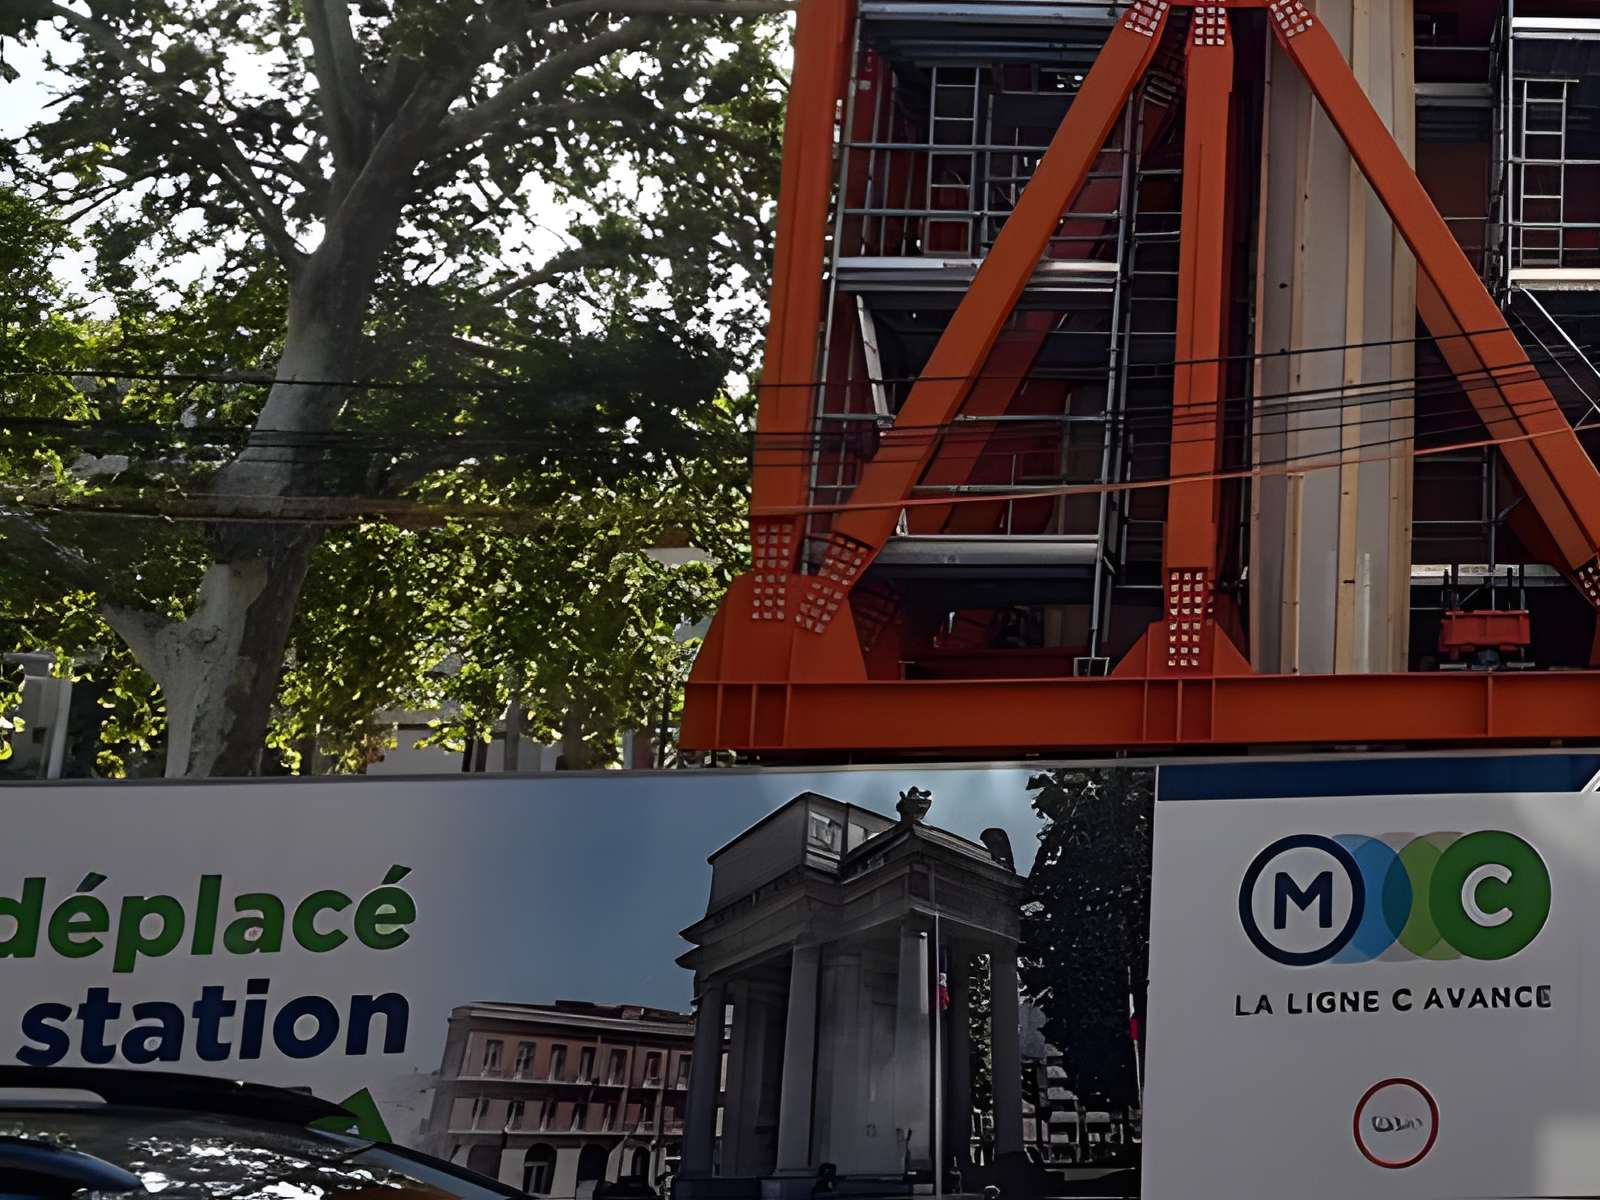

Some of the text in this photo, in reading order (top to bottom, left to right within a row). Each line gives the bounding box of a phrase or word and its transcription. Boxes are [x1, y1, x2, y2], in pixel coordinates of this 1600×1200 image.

[0, 864, 417, 974] déplacé
[1273, 871, 1333, 930] M
[1461, 863, 1513, 928] C
[15, 978, 410, 1067] station
[1235, 985, 1552, 1016] LA LIGNE C AVANCE
